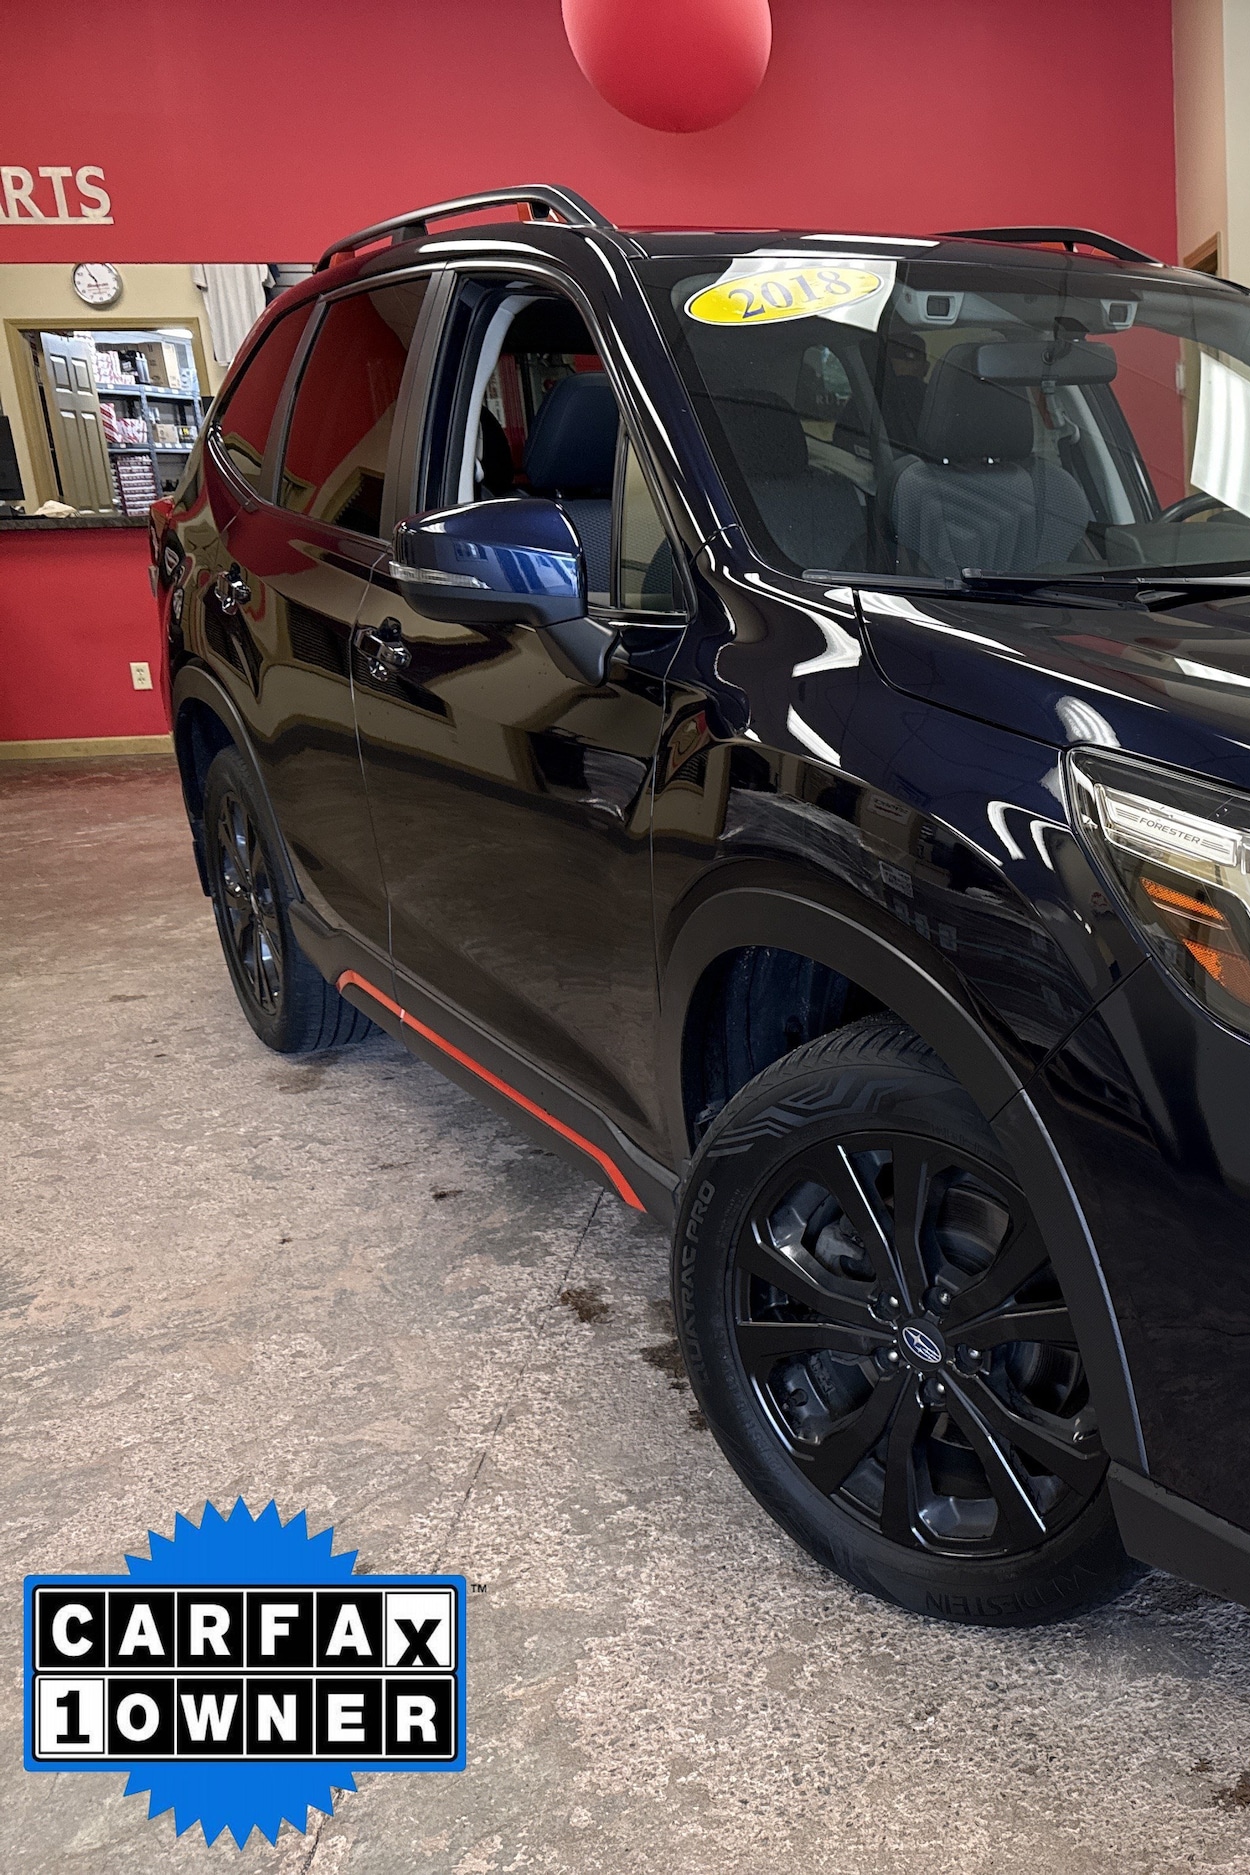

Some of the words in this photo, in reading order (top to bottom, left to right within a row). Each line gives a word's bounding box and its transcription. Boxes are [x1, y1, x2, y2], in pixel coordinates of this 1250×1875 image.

[0, 165, 112, 219] RTS
[728, 271, 851, 319] 2018
[1138, 817, 1201, 845] FORESTER
[686, 1179, 716, 1243] PRO
